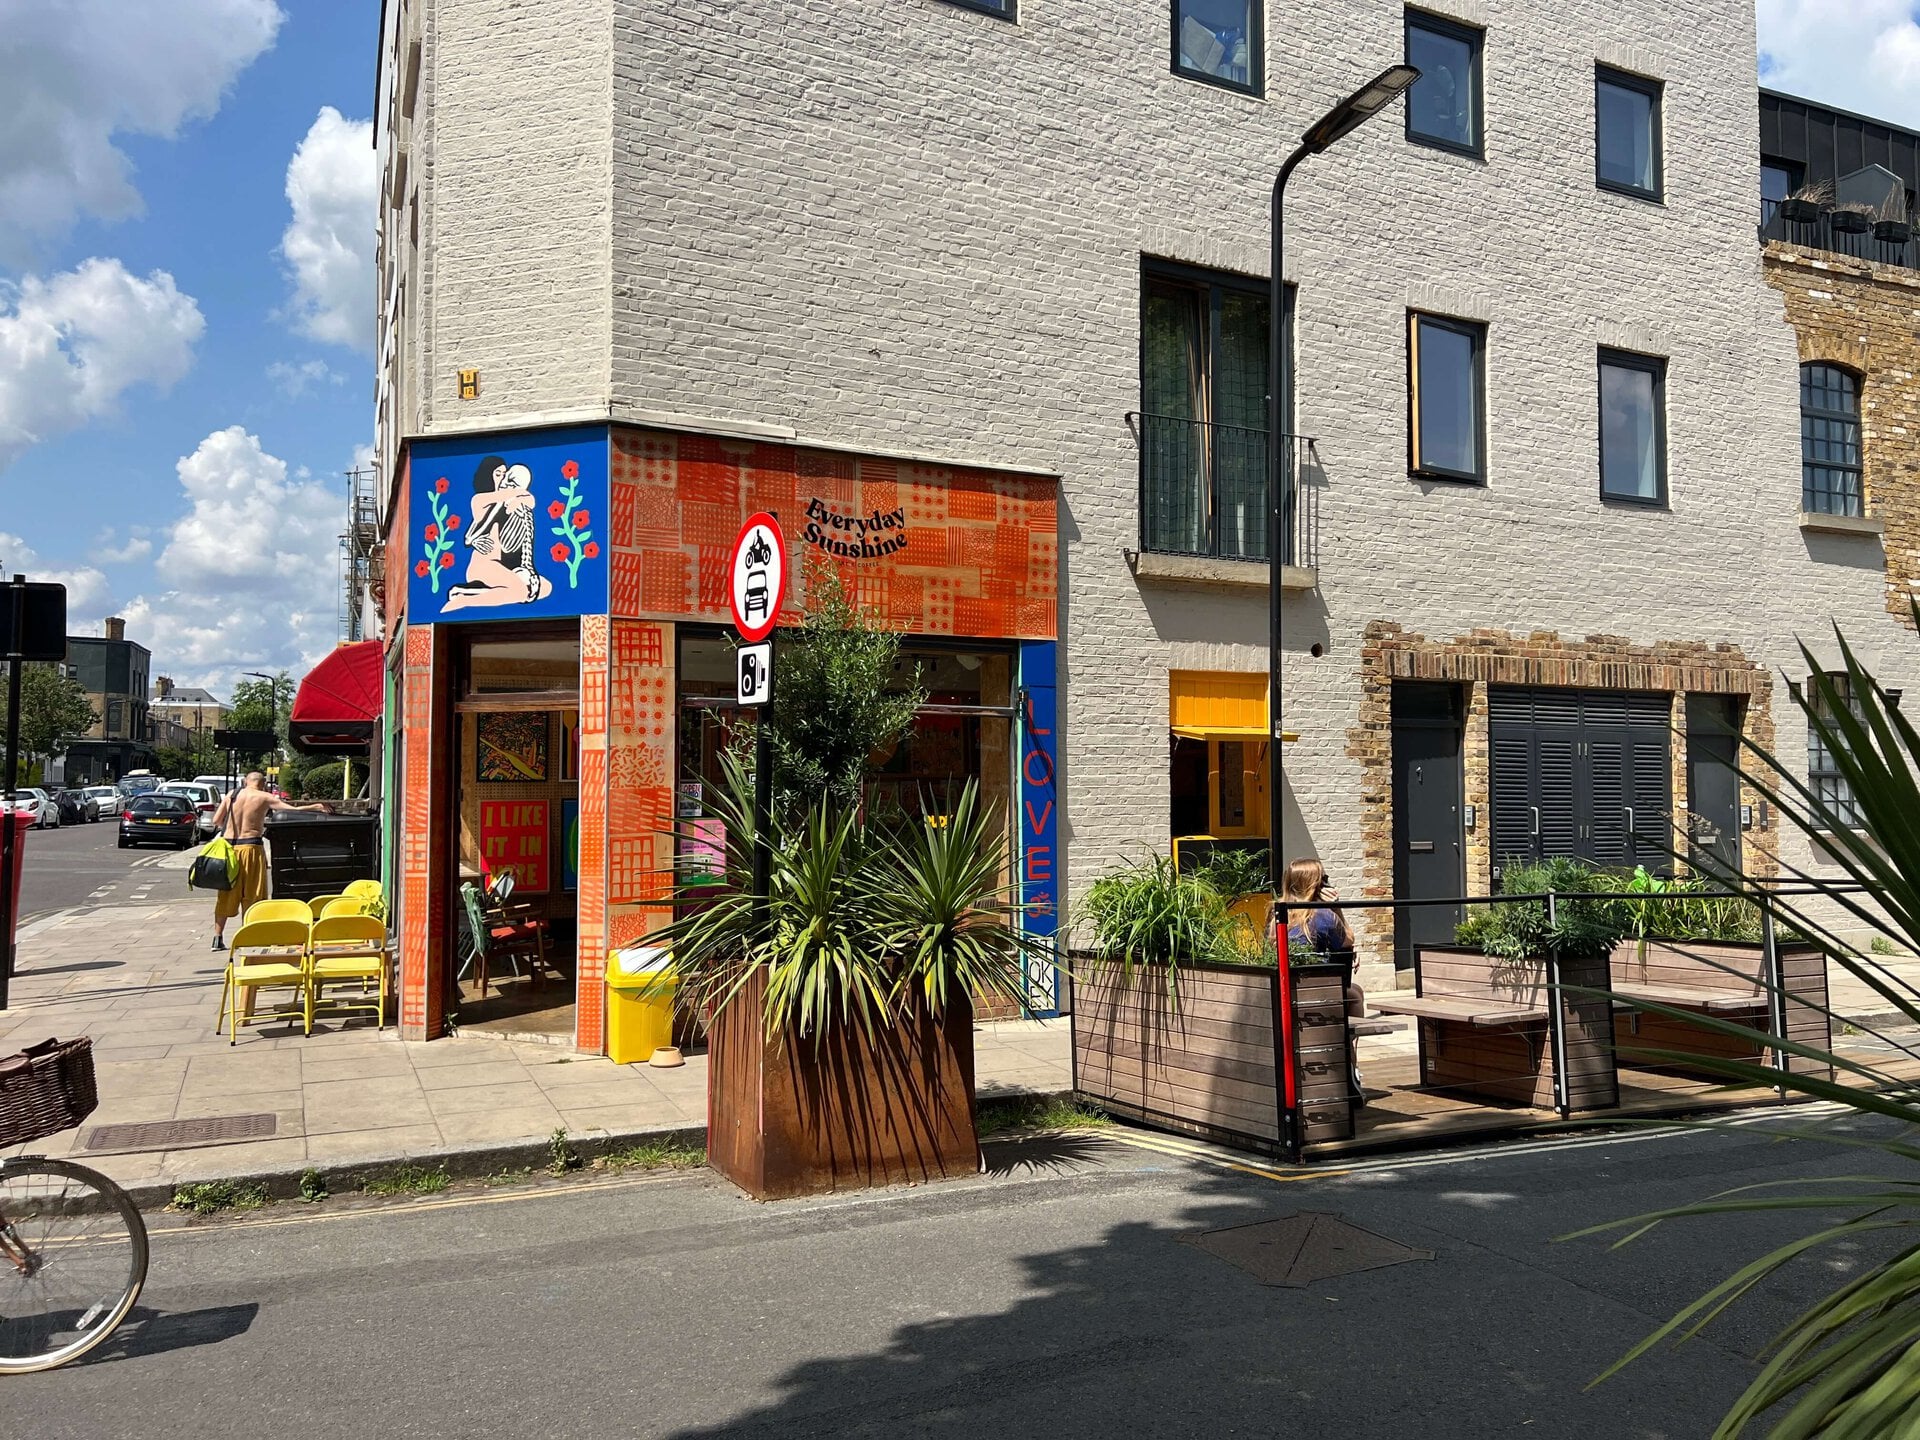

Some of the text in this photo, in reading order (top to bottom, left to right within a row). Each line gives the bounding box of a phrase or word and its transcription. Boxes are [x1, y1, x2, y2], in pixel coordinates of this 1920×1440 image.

[465, 387, 473, 395] 12
[805, 497, 905, 538] Everyday
[803, 522, 908, 558] Sunshine
[1023, 699, 1054, 880] LOVE
[484, 805, 544, 827] I LIKE
[486, 835, 542, 858] IT IN
